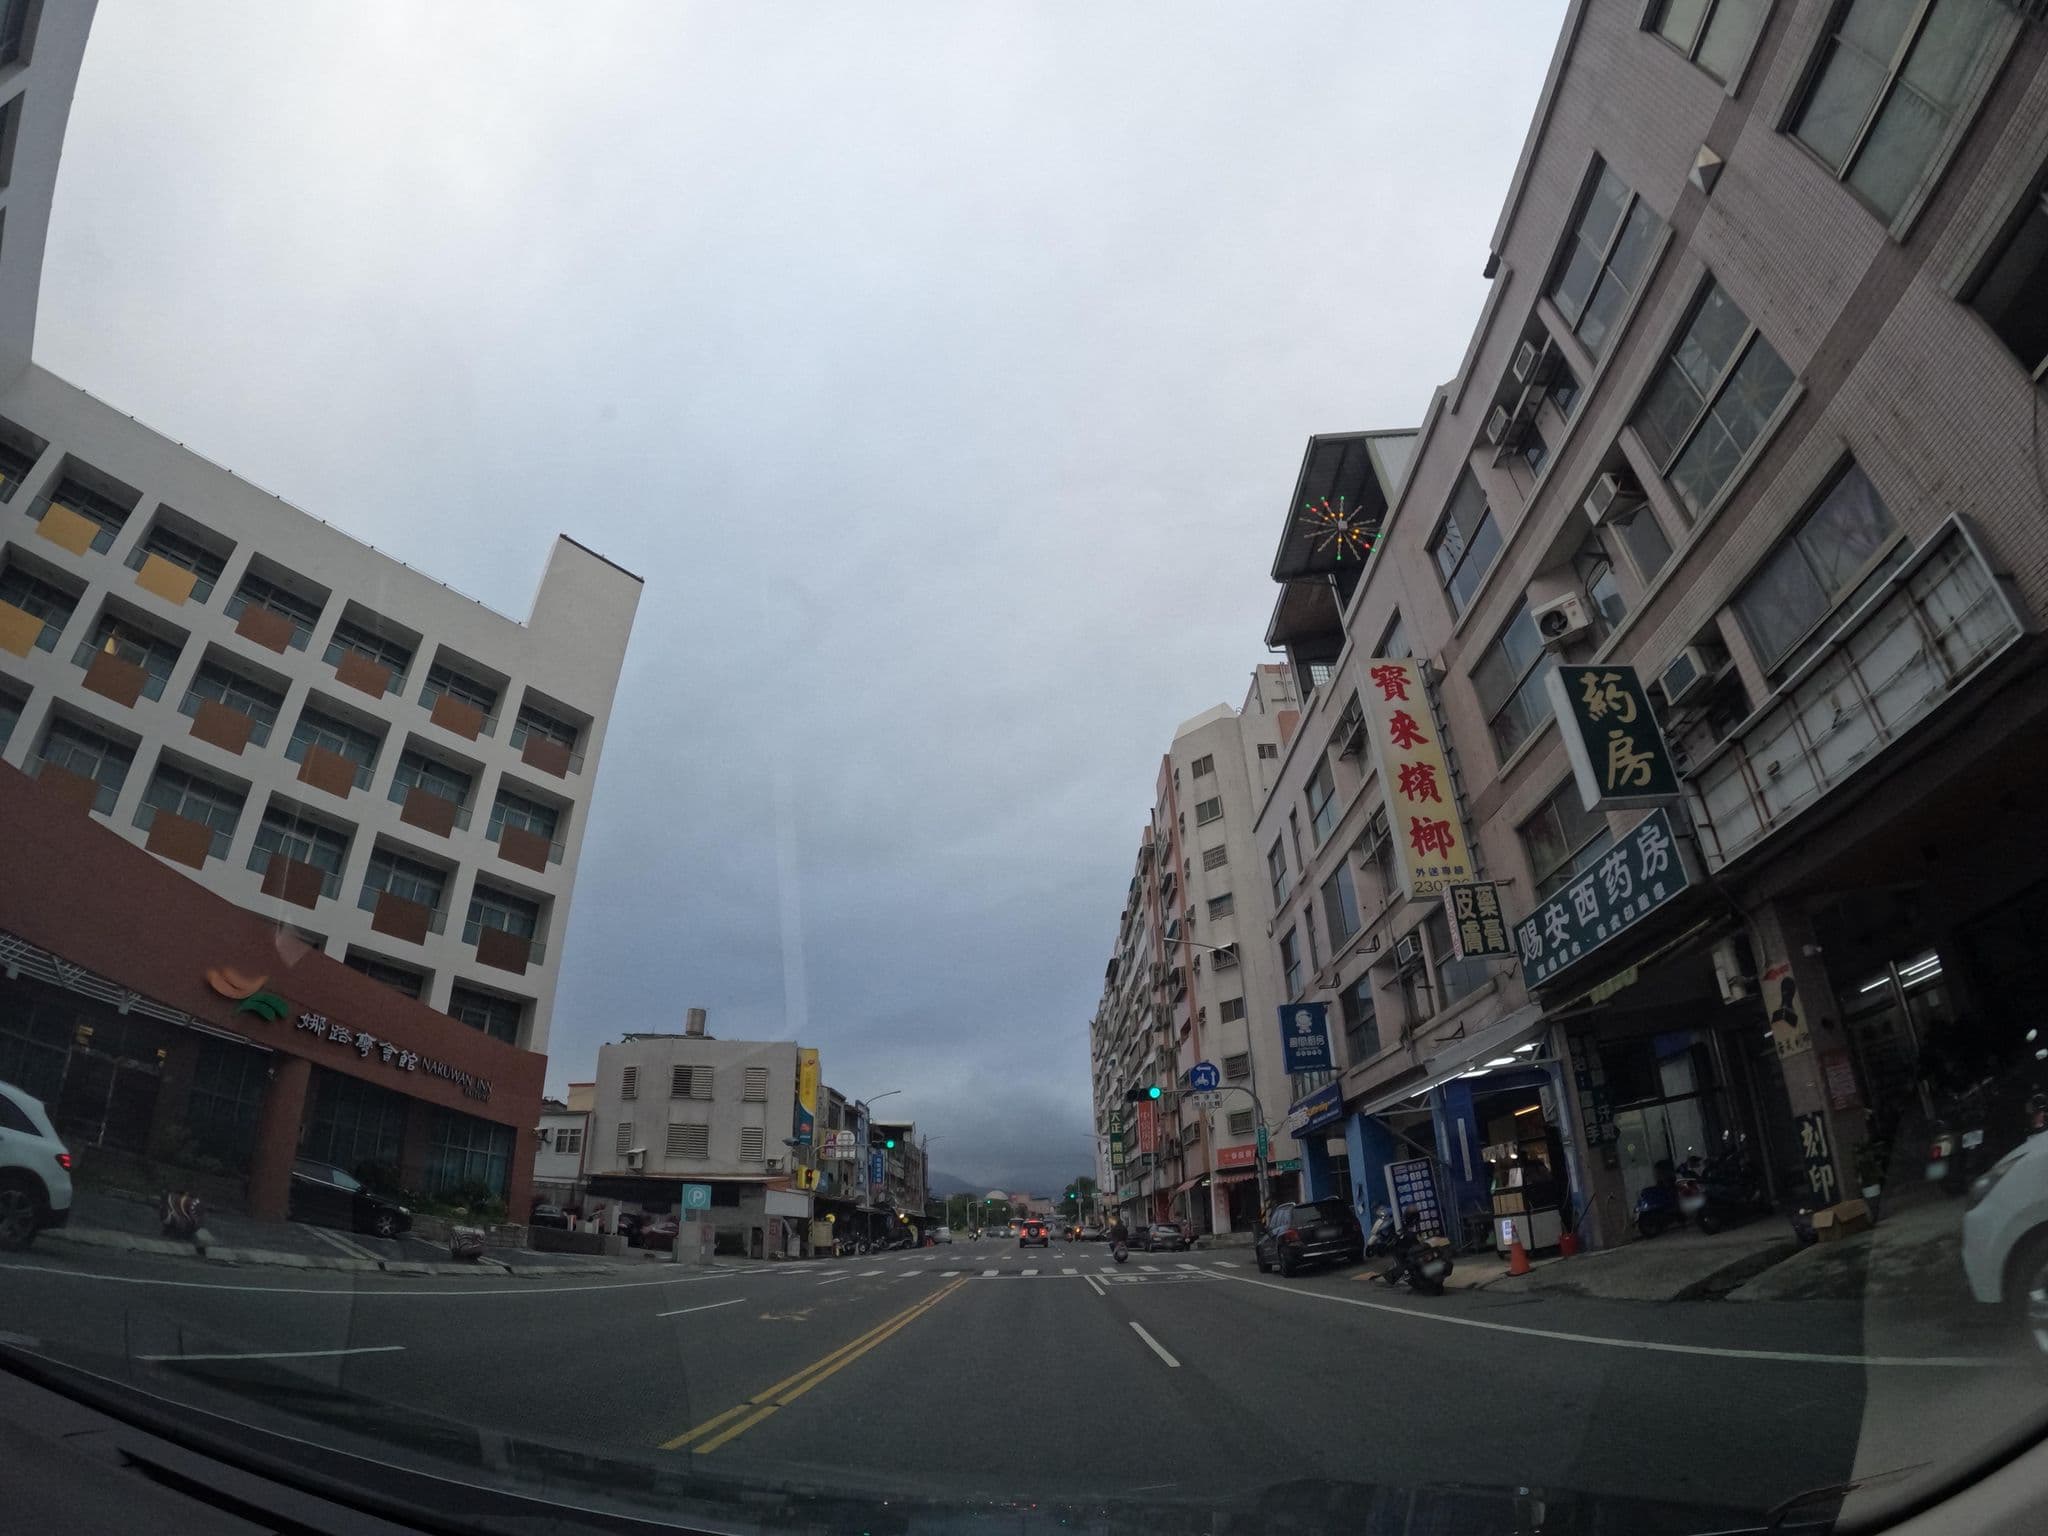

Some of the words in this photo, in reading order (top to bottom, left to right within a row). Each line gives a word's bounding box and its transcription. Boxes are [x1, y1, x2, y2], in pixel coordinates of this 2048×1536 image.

[1371, 664, 1456, 860] 寶來檳榔
[421, 1057, 473, 1087] NARUWAN
[476, 1078, 495, 1095] INN
[1800, 1113, 1835, 1204] 刻印
